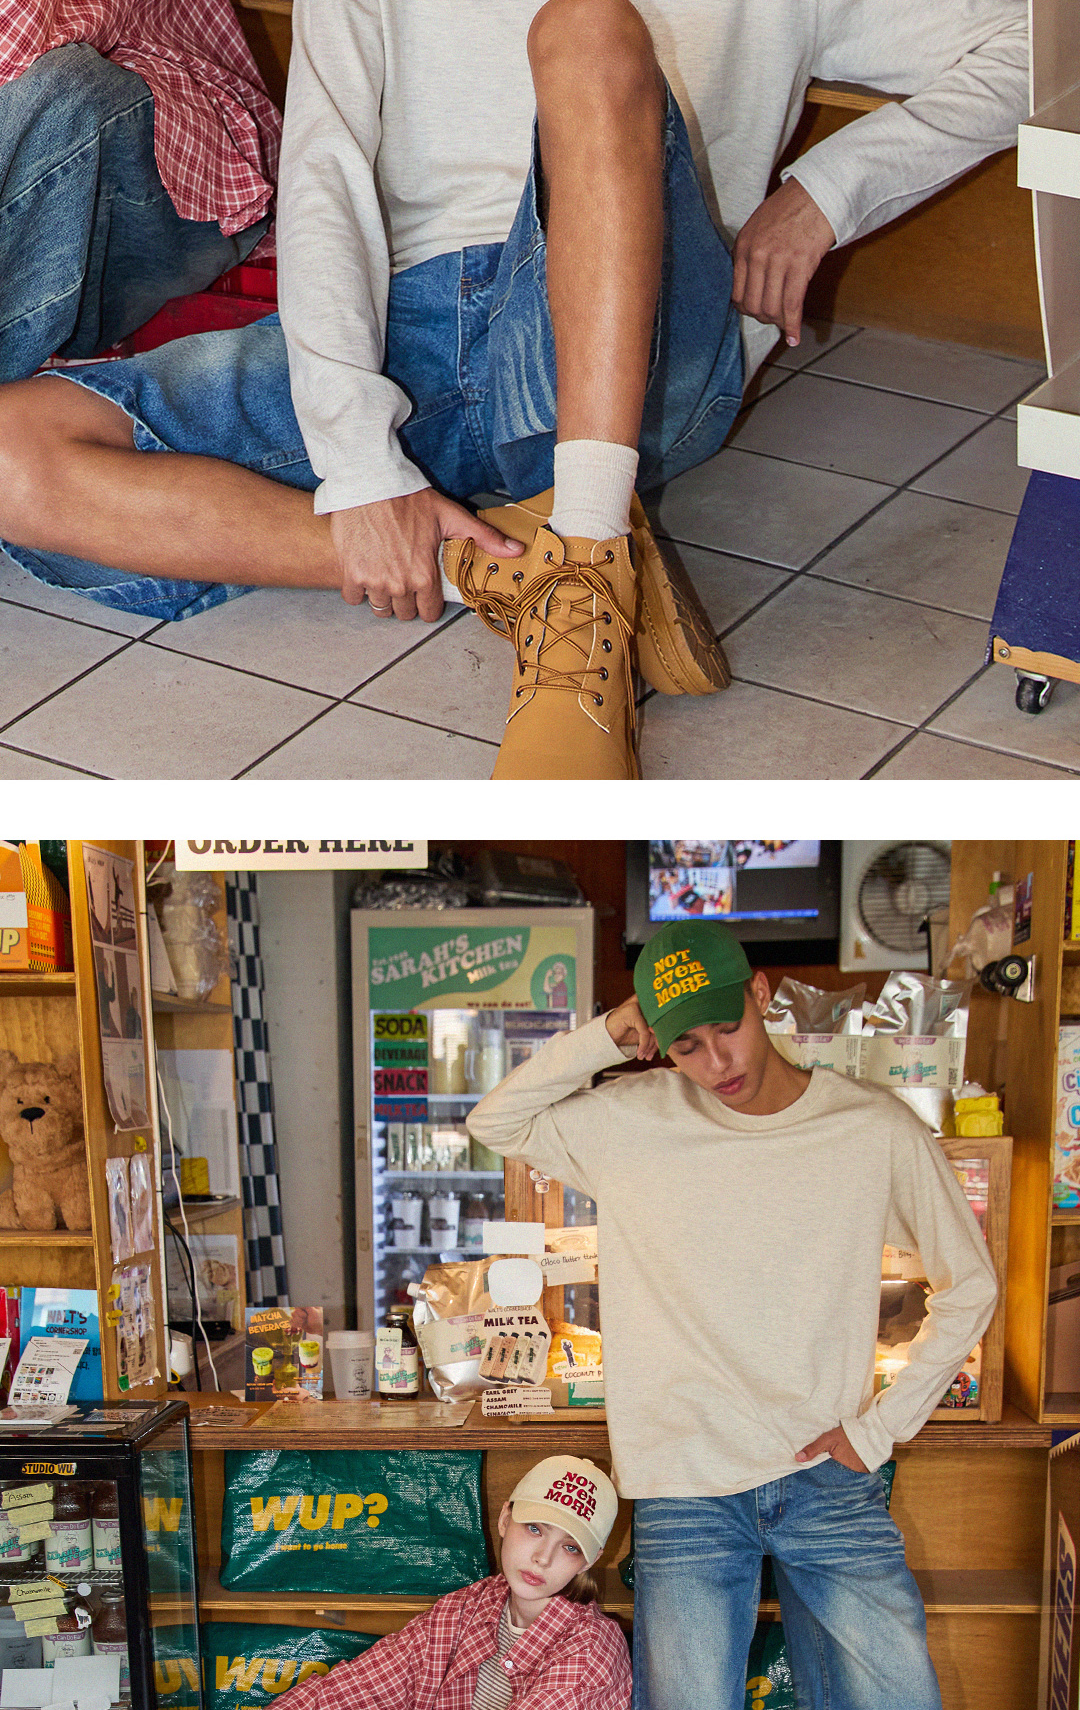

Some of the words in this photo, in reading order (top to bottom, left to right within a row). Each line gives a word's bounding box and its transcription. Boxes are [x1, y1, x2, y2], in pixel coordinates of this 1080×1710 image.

[371, 934, 470, 986] SARAH'S
[421, 934, 523, 988] KITCHEN
[654, 948, 691, 976] NOT
[467, 965, 496, 984] Milk
[653, 959, 705, 991] even
[655, 972, 711, 1008] MORE
[376, 1018, 425, 1036] SODA
[375, 1074, 426, 1091] SNACK
[375, 1104, 401, 1118] MILK
[405, 1103, 428, 1117] TEA
[47, 1309, 87, 1325] WALT'S
[251, 1312, 282, 1323] MATCHA
[484, 1317, 514, 1327] MILK
[519, 1316, 538, 1325] TEA
[46, 1326, 87, 1335] CORNERSHOP
[248, 1320, 291, 1335] BEVERAGE
[22, 1462, 55, 1474] STUDIO
[563, 1471, 597, 1496] NOT
[553, 1480, 597, 1511] even
[250, 1492, 389, 1532] WUP?
[543, 1488, 595, 1522] MORE
[279, 1543, 301, 1551] want
[302, 1543, 312, 1551] to
[313, 1543, 325, 1552] go
[326, 1542, 348, 1550] home
